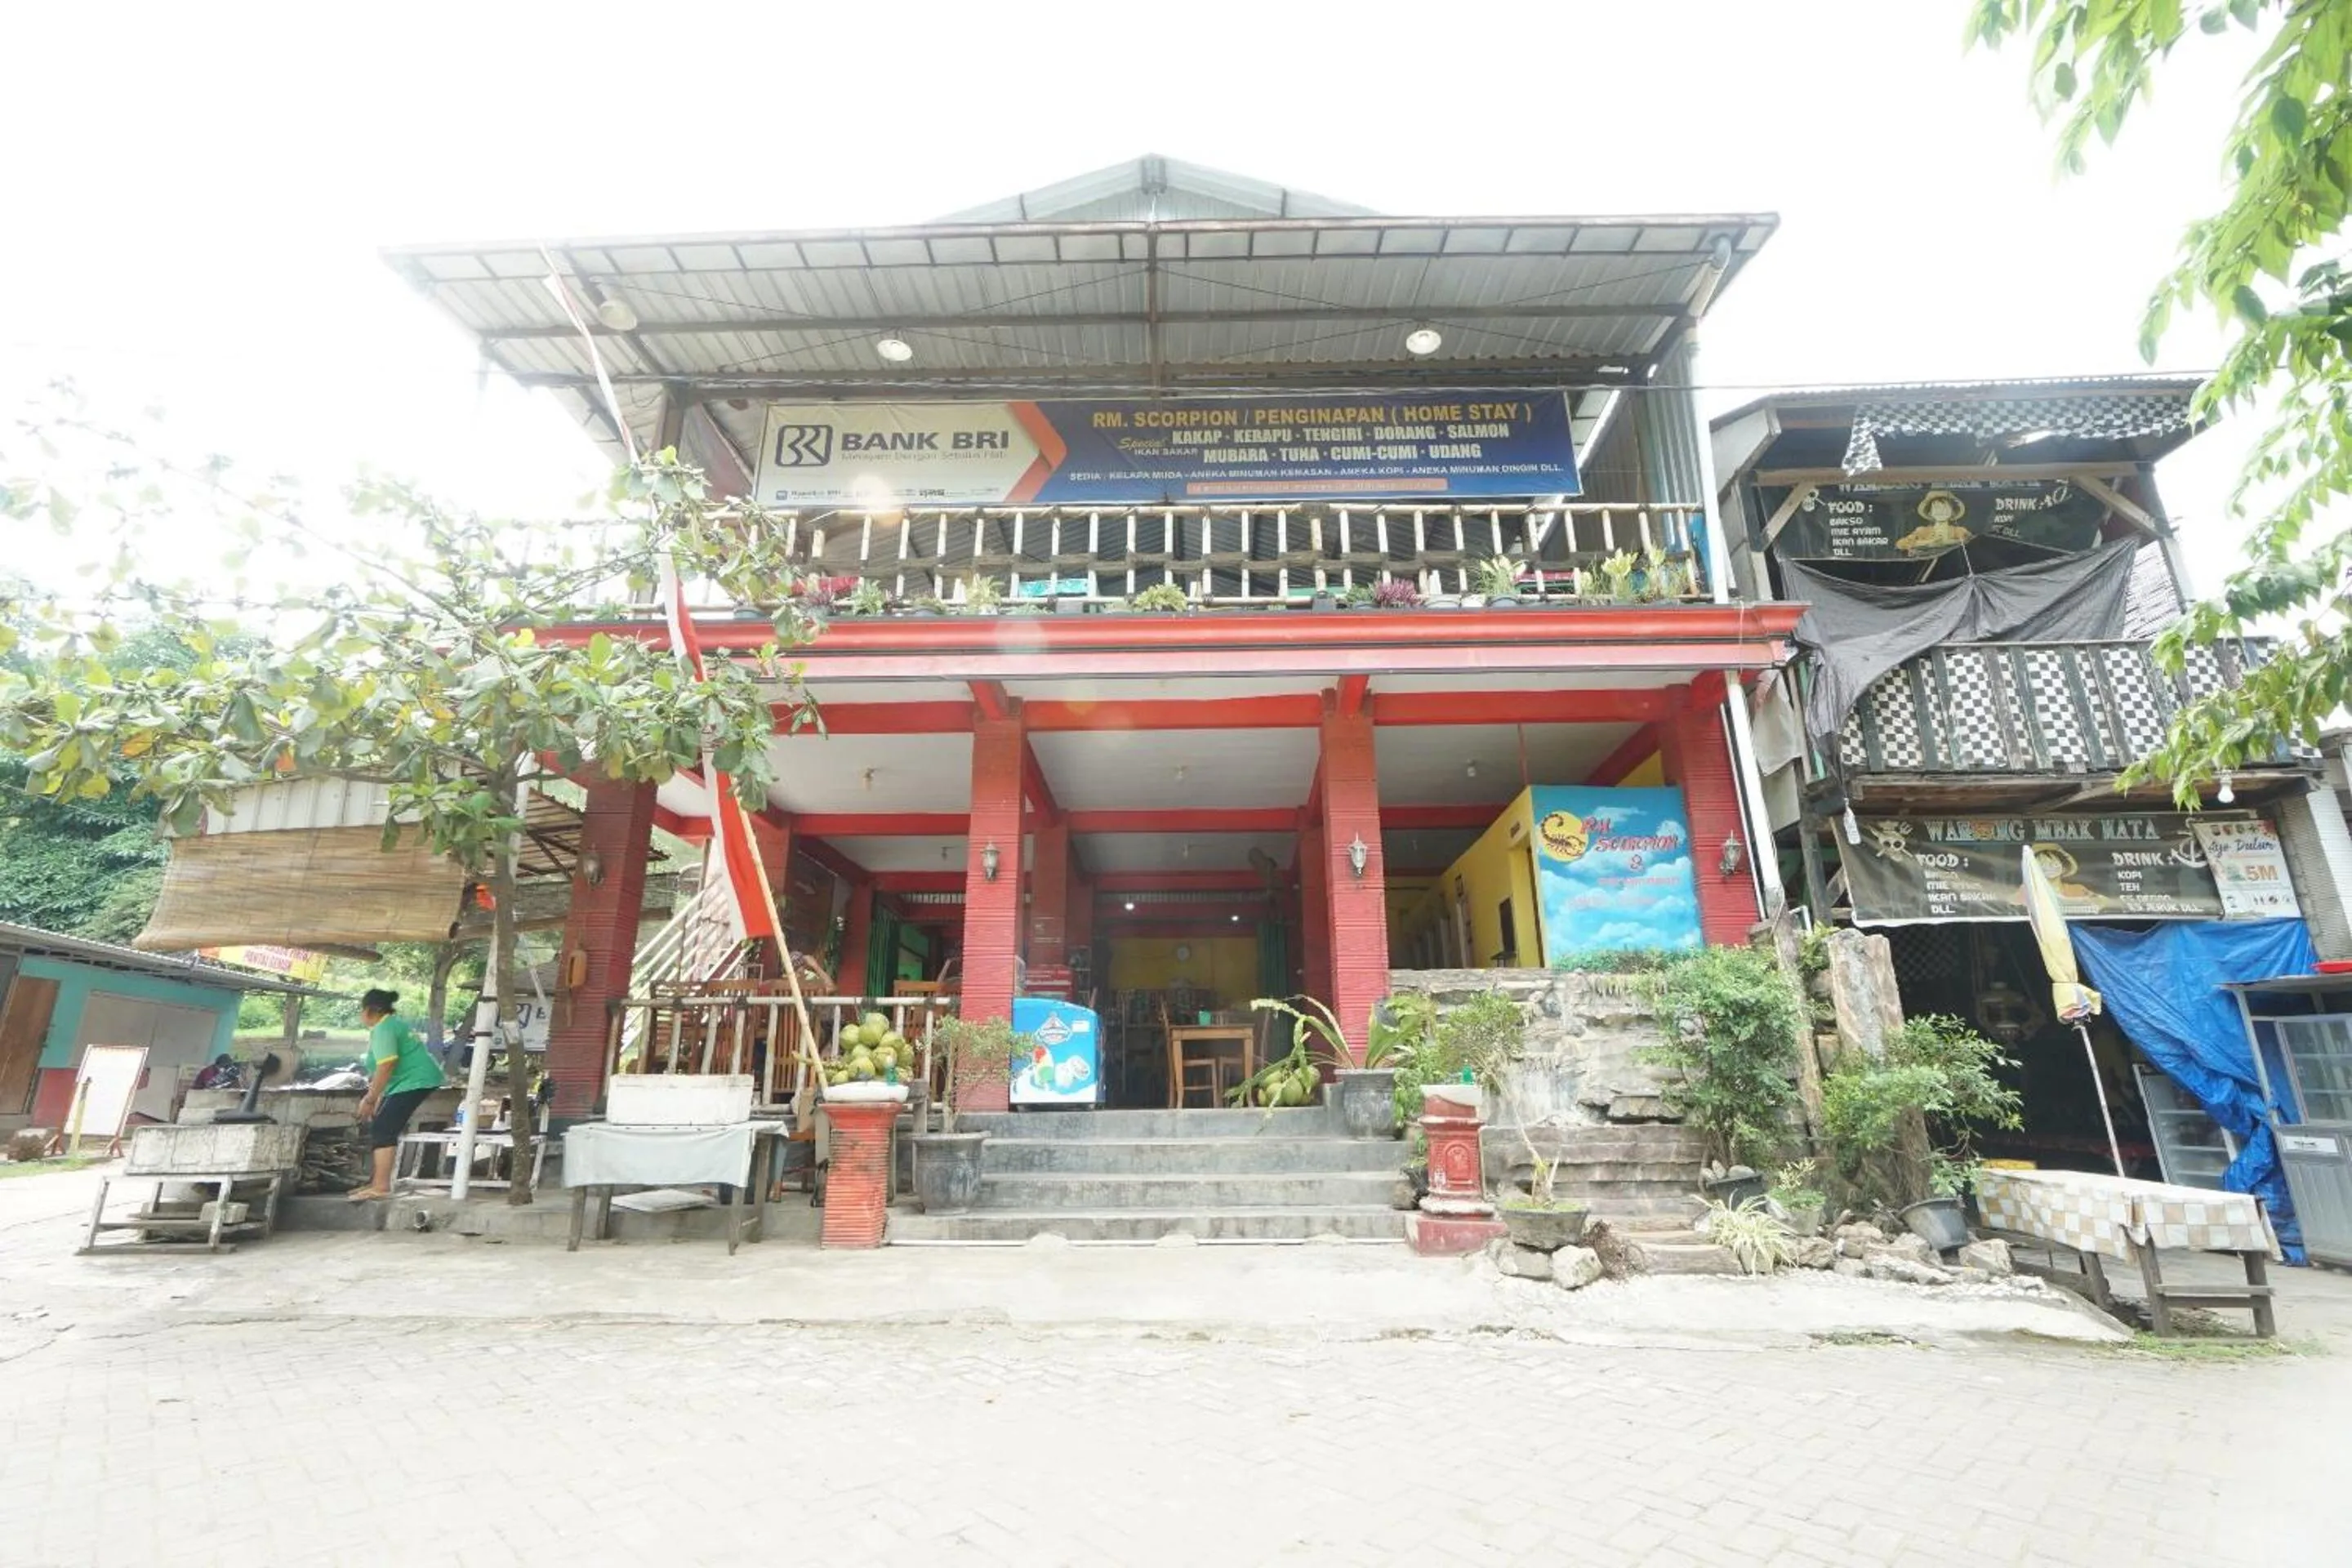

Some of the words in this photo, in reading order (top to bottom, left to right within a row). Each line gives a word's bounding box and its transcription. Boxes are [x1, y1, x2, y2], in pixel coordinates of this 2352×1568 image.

[1093, 412, 1129, 429] RM.
[1134, 410, 1238, 428] SCORPION
[1254, 405, 1387, 425] PENGINAPAN
[1403, 403, 1462, 422] HOME
[1468, 402, 1521, 421] STAY
[841, 430, 940, 451] BANK
[951, 430, 1010, 450] BRI
[1173, 430, 1222, 444] KAKAP
[1233, 429, 1292, 443] KERAPU
[1305, 426, 1363, 443] TENGIRI
[1374, 425, 1437, 441] DORANG
[1447, 422, 1510, 439] SALMON
[1203, 447, 1269, 464] MUBARA
[1280, 447, 1321, 462] TUNA
[1330, 443, 1418, 461] CUMI-CUMI
[1428, 443, 1482, 460] UDANG
[1828, 500, 1865, 514] FOOD
[1923, 820, 2025, 842] WARNG
[2033, 819, 2095, 840] MBAK
[1915, 853, 1959, 868] FOOD
[2112, 851, 2165, 867] DRINK
[2116, 869, 2143, 880] KOPI
[2245, 865, 2279, 881] 5M
[2119, 882, 2140, 892] TEH
[1930, 903, 1957, 915] DLL
